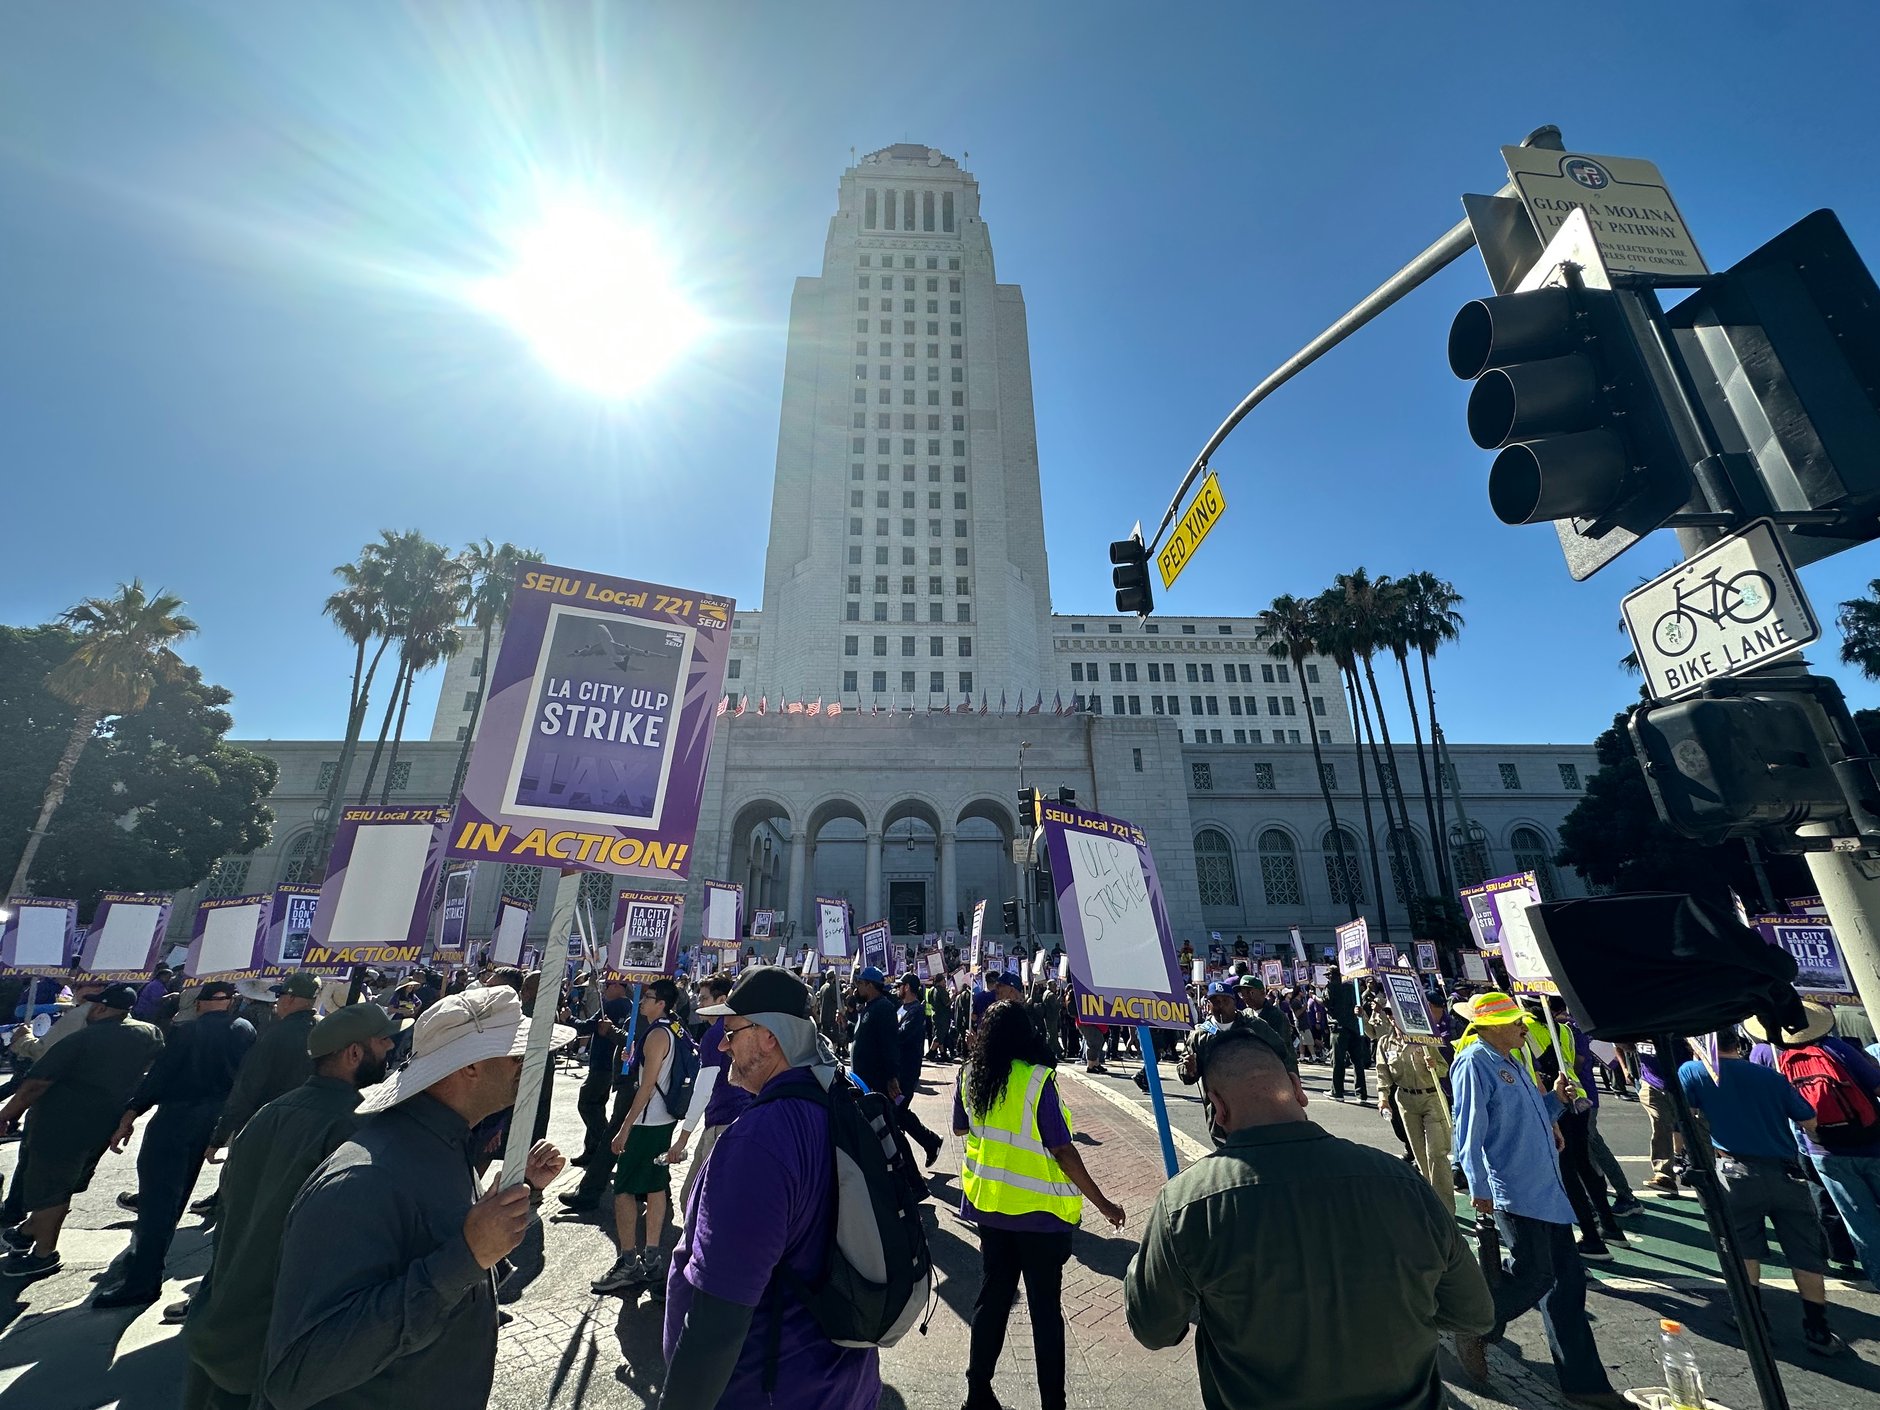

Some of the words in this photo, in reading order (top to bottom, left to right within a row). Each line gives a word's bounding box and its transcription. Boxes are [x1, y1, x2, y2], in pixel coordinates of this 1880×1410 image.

[1604, 205, 1675, 223] MOLINA
[1608, 222, 1677, 239] PATHWAY
[1617, 244, 1655, 254] ELECTED
[1669, 249, 1687, 257] THE
[1628, 254, 1646, 262] CITY
[1648, 257, 1687, 266] COUNCIL
[1163, 536, 1186, 578] PED
[1186, 489, 1217, 545] XING
[522, 572, 582, 596] SEIU
[585, 583, 649, 608] Local
[652, 594, 694, 616] 721
[697, 618, 726, 630] SEIU
[1665, 652, 1718, 691] BIKE
[1722, 618, 1792, 666] LANE
[548, 678, 571, 699] LA
[579, 681, 624, 704] CITY
[631, 688, 669, 711] ULP
[540, 702, 664, 748] STRIKE
[344, 810, 374, 821] SEIU
[376, 810, 408, 820] Local
[412, 810, 433, 820] 721
[1045, 808, 1074, 824] SEIU
[1078, 815, 1108, 832] Local
[1111, 823, 1129, 838] 721
[455, 822, 512, 852] IN
[512, 828, 689, 870] ACTION!
[1078, 840, 1119, 878] ULP
[1486, 883, 1498, 892] SEIU
[1499, 881, 1512, 890] Local
[1513, 878, 1524, 886] 721
[294, 901, 305, 910] LA
[1084, 866, 1146, 941] STRIKE
[446, 907, 464, 920] STRIKE
[634, 908, 644, 918] LA
[648, 909, 667, 919] CITY
[632, 918, 654, 927] DON'T
[631, 926, 665, 937] TRASH!
[1802, 932, 1824, 940] CITY
[305, 947, 331, 963] IN
[333, 946, 422, 963] ACTION!
[1791, 944, 1829, 959] ULP
[76, 973, 94, 981] IN
[95, 972, 153, 980] ACTION!
[264, 966, 281, 975] IN
[608, 972, 621, 980] IN
[182, 978, 199, 987] IN
[201, 969, 260, 985] ACTION!
[1513, 982, 1523, 992] IN
[1081, 994, 1104, 1016] IN
[1111, 996, 1190, 1023] ACTION!
[1413, 1036, 1443, 1044] ACTION!
